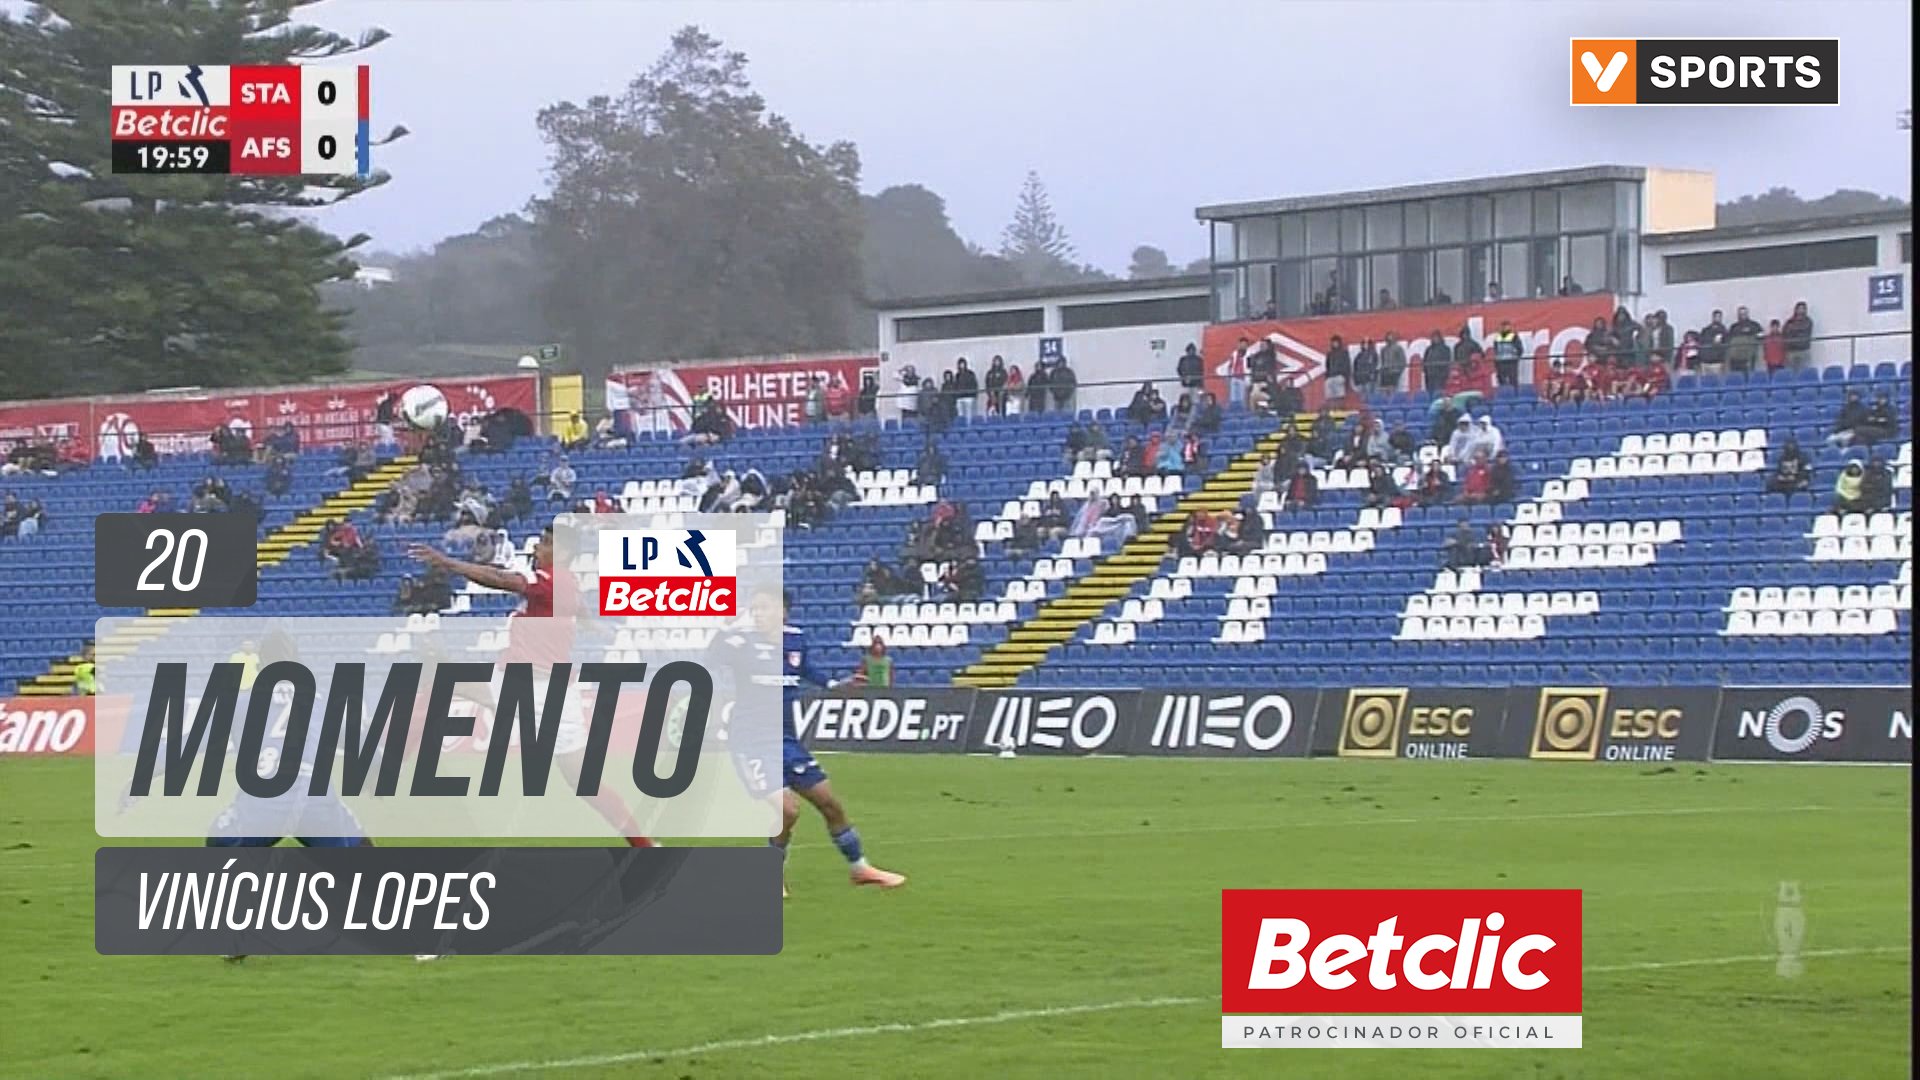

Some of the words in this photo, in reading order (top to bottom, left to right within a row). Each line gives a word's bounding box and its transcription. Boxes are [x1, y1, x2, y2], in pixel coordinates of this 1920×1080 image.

[1878, 279, 1896, 294] 15
[707, 370, 849, 401] BILHETERA
[724, 403, 801, 429] NLINE
[984, 694, 1118, 750] MEO
[1151, 694, 1294, 751] MEO
[1408, 706, 1475, 738] ESC
[1610, 708, 1682, 740] ESC
[1738, 695, 1845, 753] NOS
[1405, 742, 1469, 760] ONLINE
[1605, 744, 1676, 762] ONLINE
